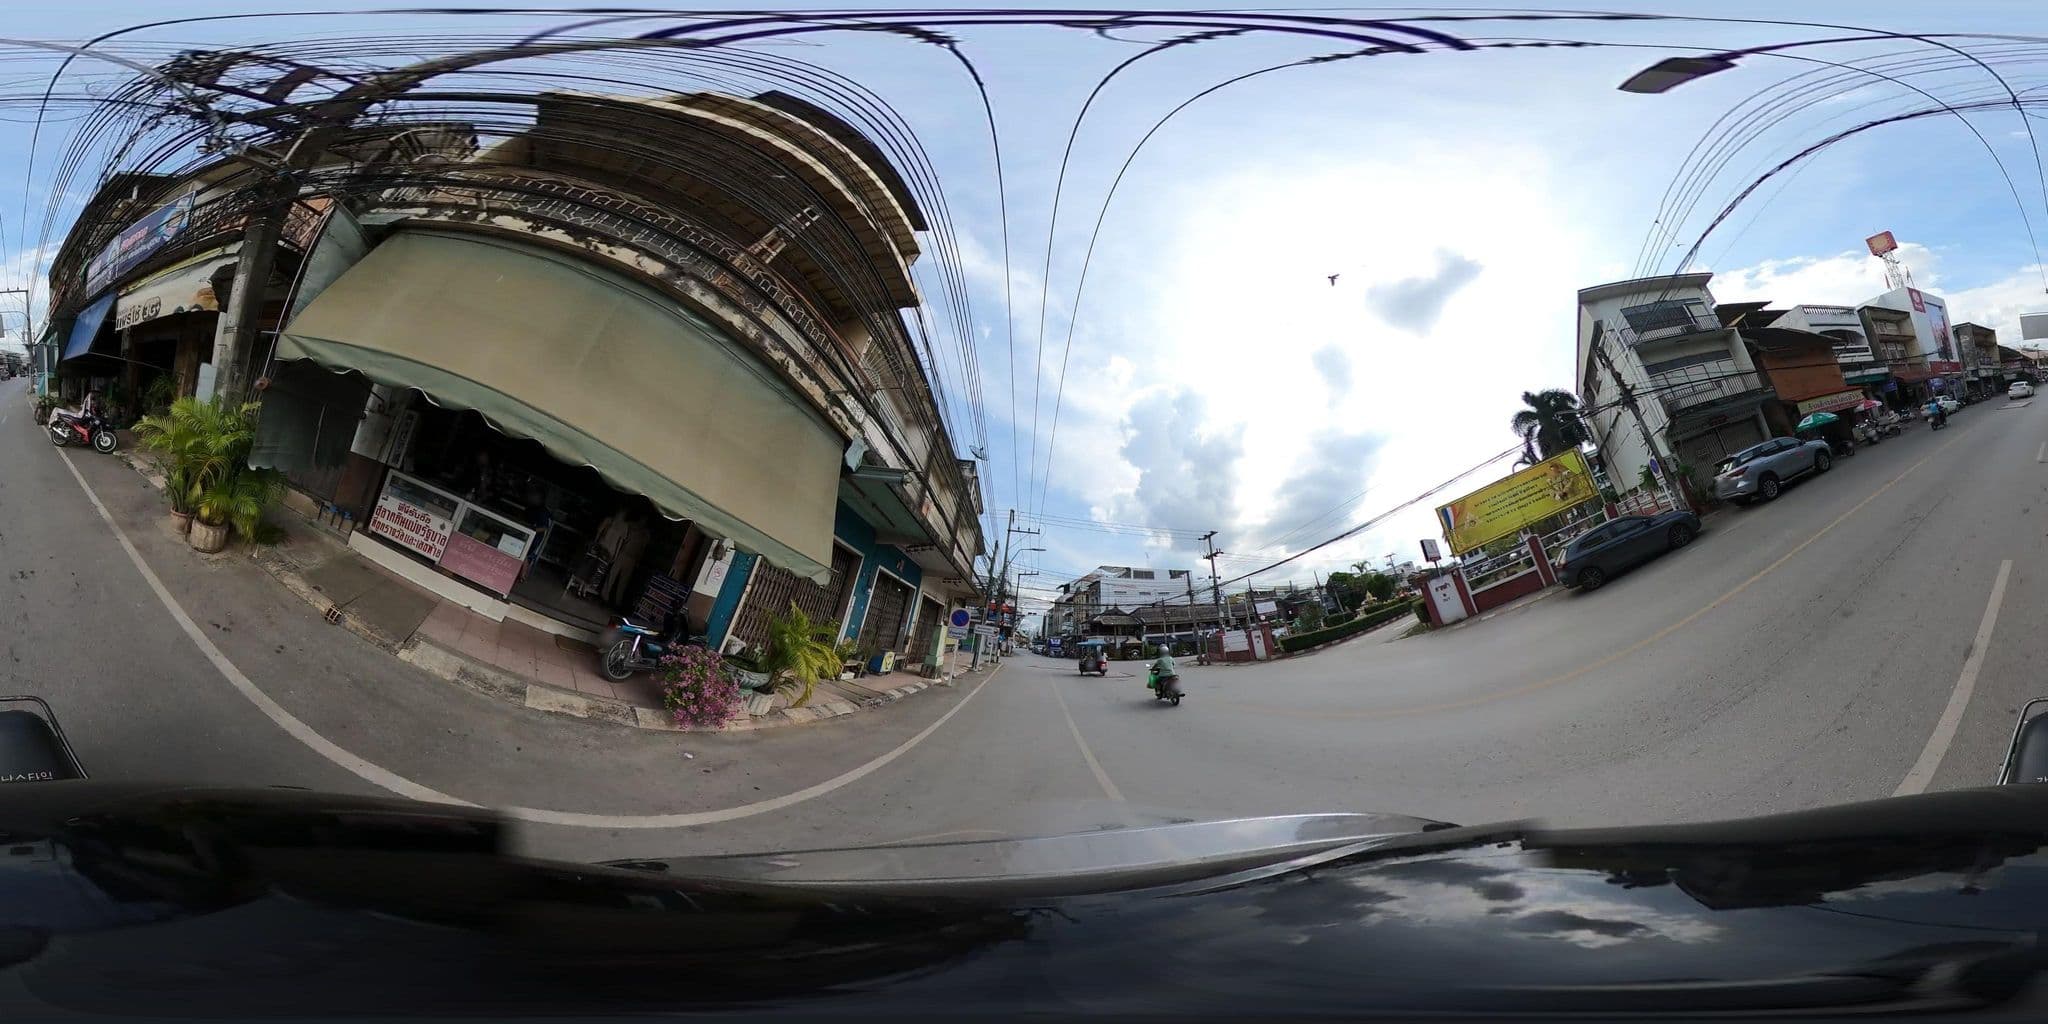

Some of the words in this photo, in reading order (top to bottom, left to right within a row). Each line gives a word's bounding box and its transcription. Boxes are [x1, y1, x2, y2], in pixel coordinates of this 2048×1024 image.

[375, 505, 448, 546] สลากกินแบ่งรัฐบาล
